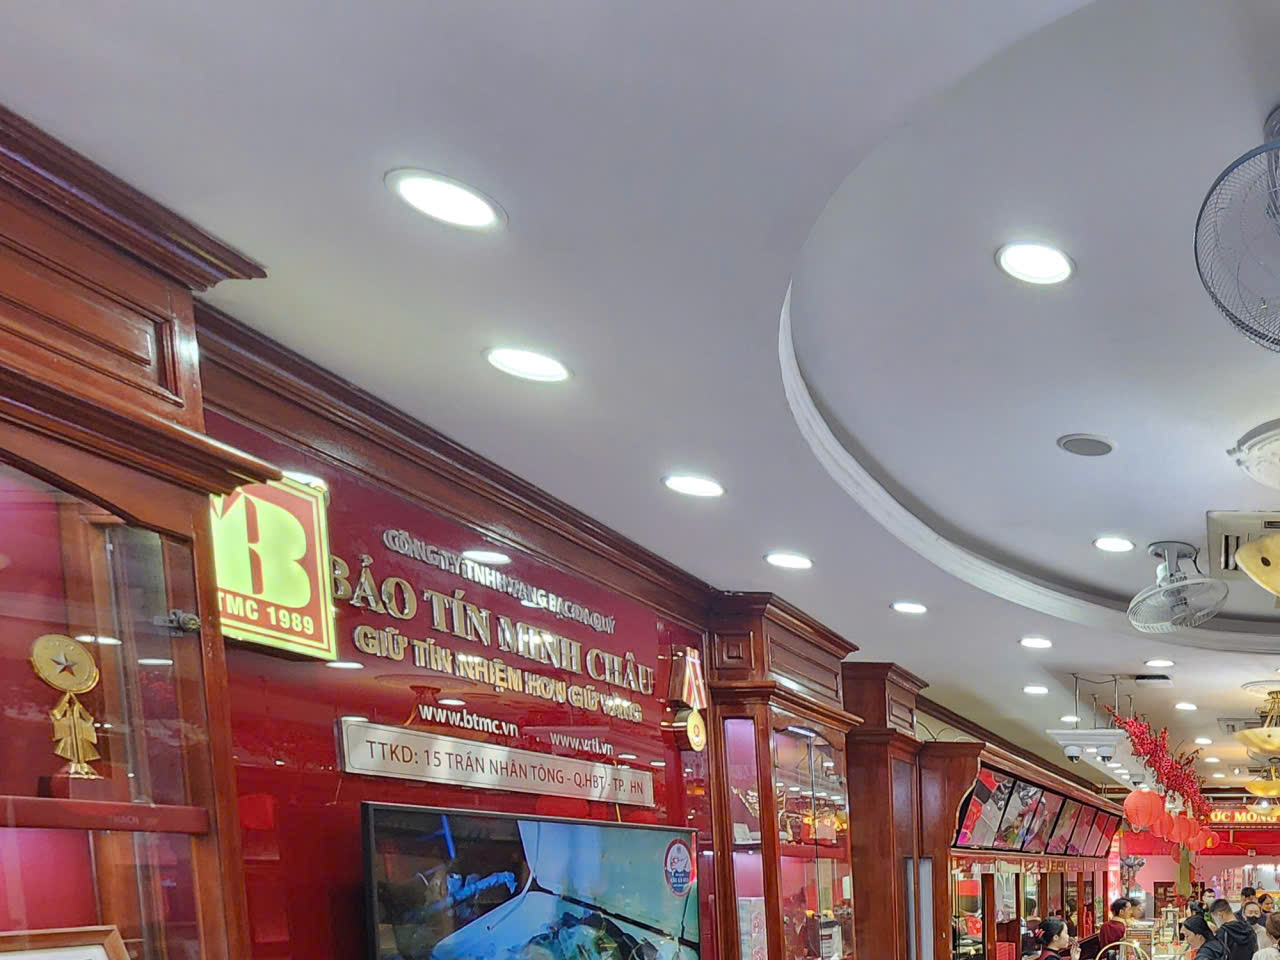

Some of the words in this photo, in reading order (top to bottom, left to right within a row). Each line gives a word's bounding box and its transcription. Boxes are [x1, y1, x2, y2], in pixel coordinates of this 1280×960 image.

[266, 605, 315, 635] 1989
[330, 554, 418, 621] BẢO
[422, 588, 492, 647] TÍN
[496, 614, 584, 676] MINH
[585, 651, 655, 696] CHÂU
[353, 624, 409, 661] GIỮ
[410, 637, 452, 674] TÍN
[453, 650, 523, 693] NHIỆM
[566, 684, 602, 713] GIỮ
[417, 702, 520, 738] www.btmc.vn
[549, 731, 615, 756] www.vrtl.vn
[365, 739, 419, 765] TTKD:
[423, 748, 442, 768] 15
[489, 758, 528, 780] NHÂN
[530, 764, 564, 785] TÔNG
[612, 777, 626, 793] TP.
[629, 780, 644, 795] HN
